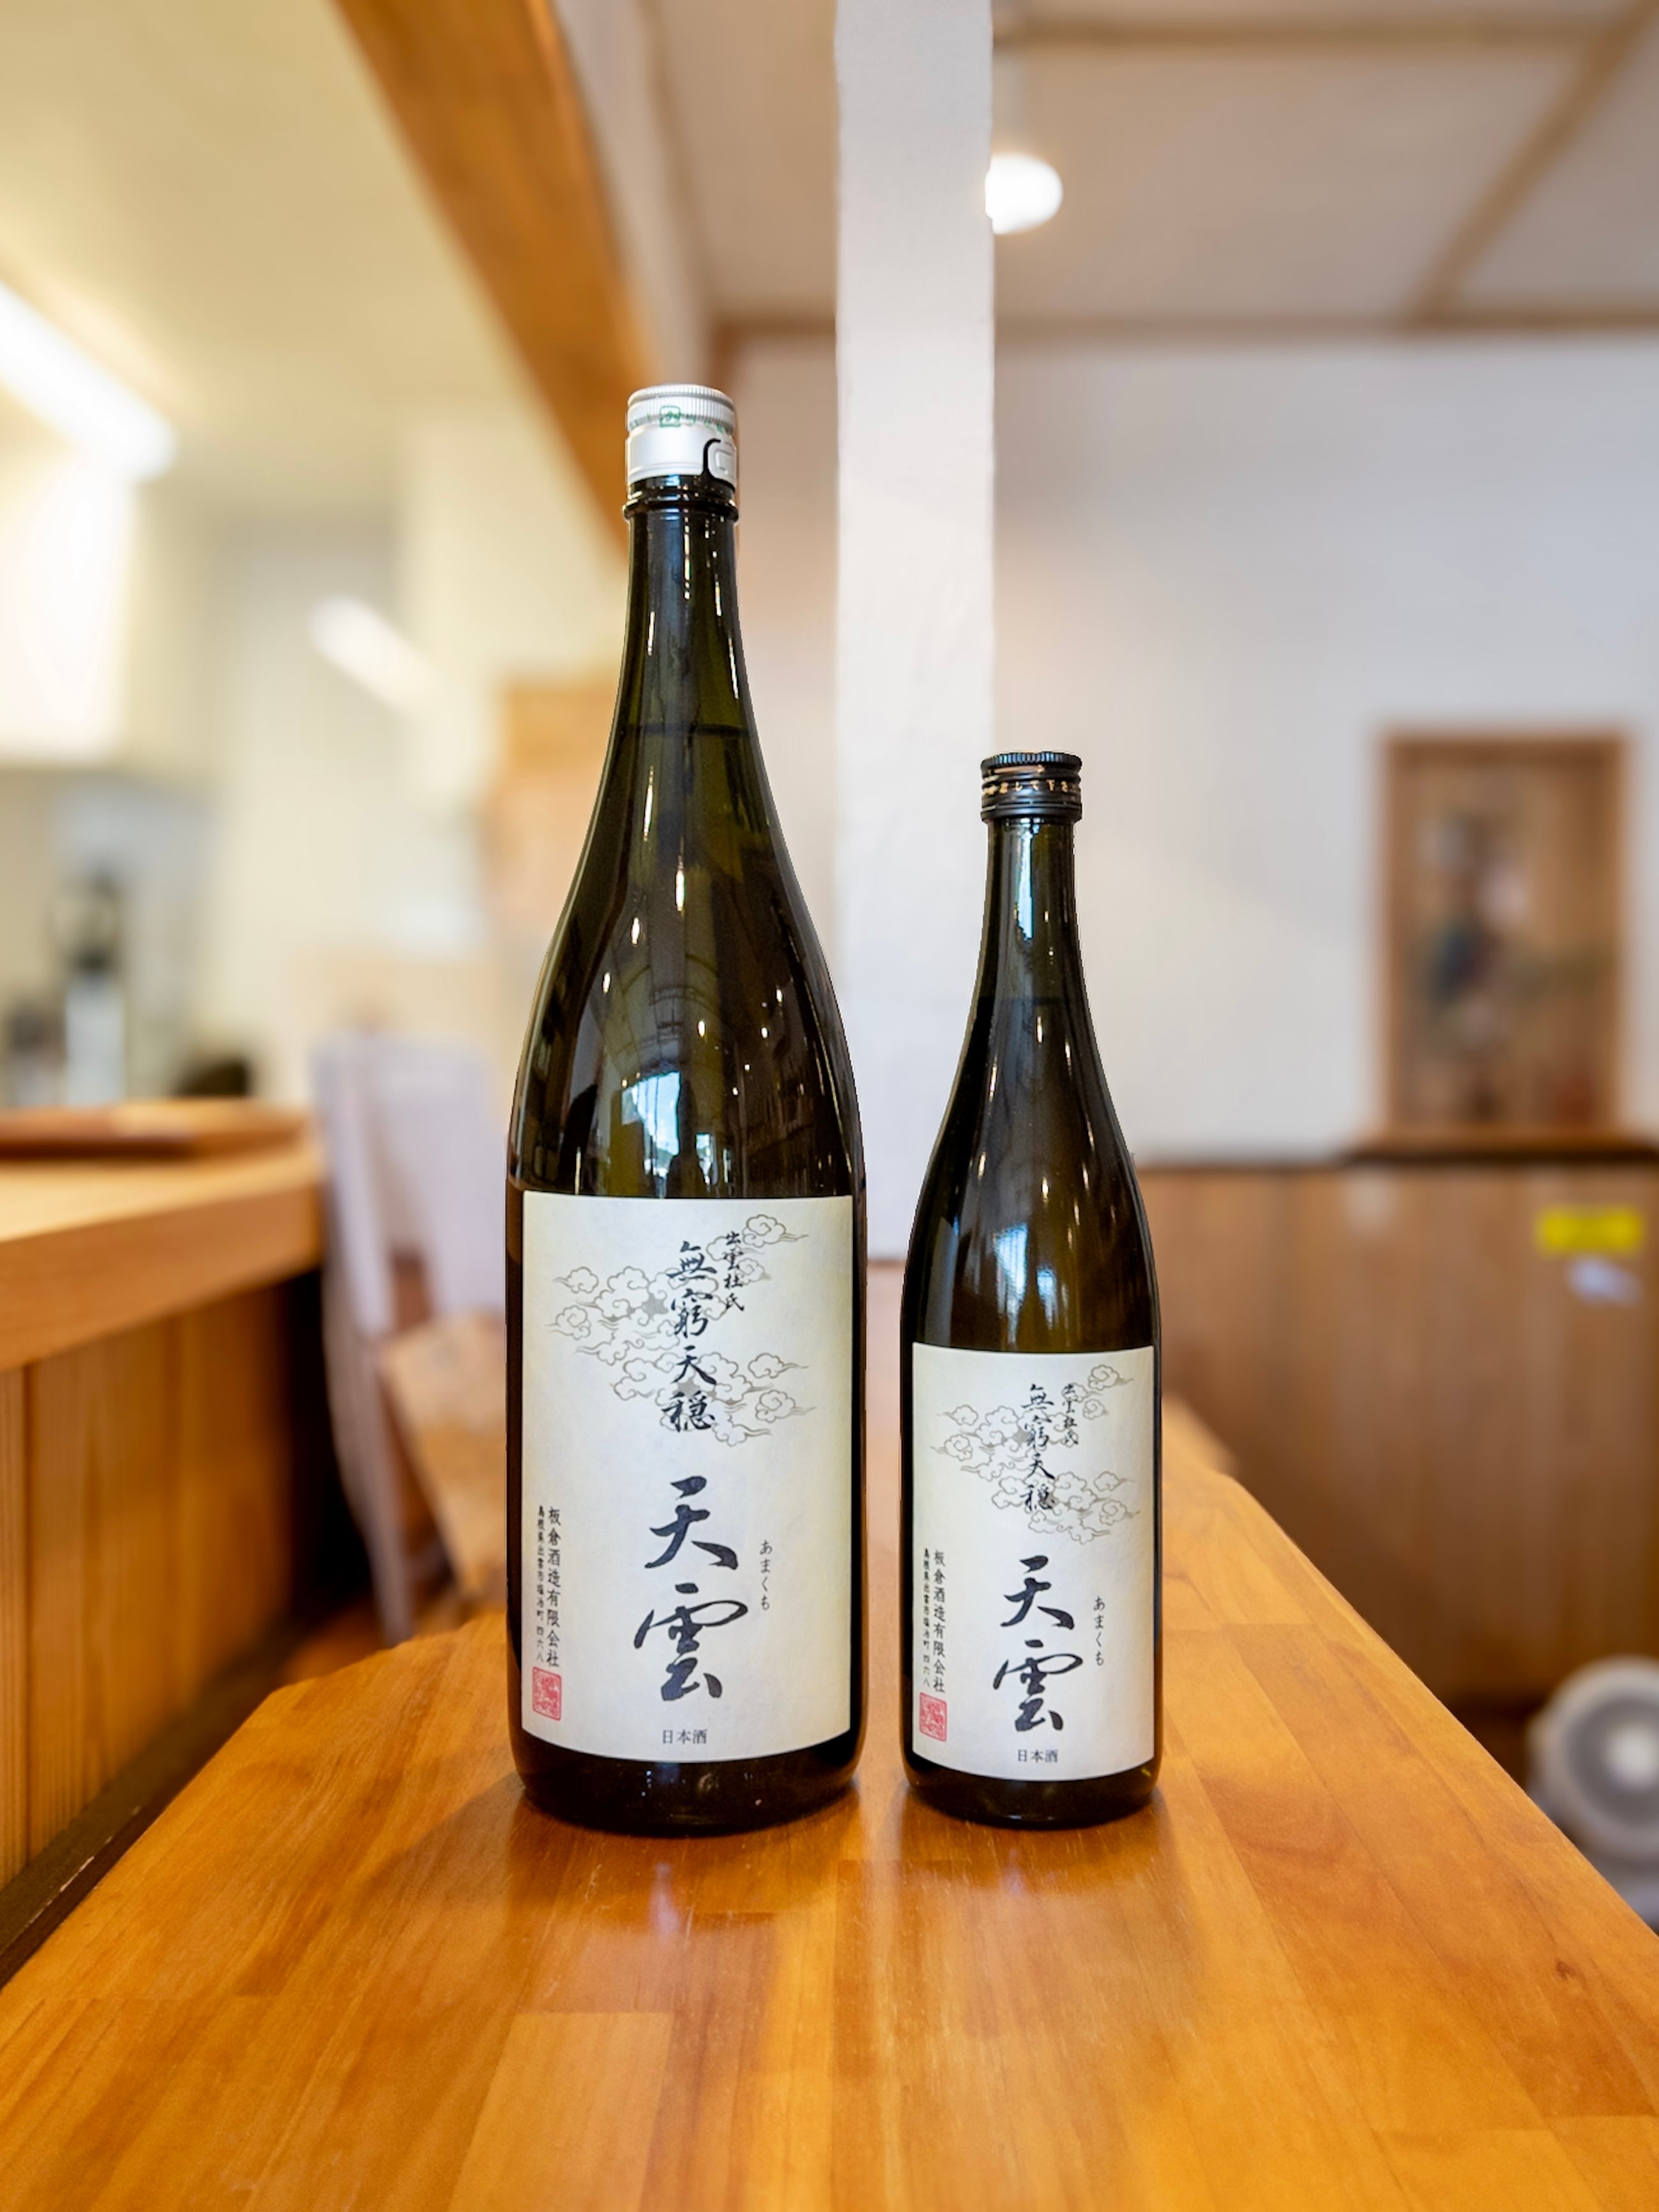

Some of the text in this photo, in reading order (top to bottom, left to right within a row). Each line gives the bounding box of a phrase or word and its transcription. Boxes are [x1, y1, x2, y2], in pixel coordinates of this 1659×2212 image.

[547, 1506, 561, 1666] 板倉酒造有限会社
[633, 1475, 748, 1701] 天雲
[759, 1540, 773, 1610] あまくも
[933, 1550, 945, 1692] 板倉酒造有限会社
[992, 1555, 1083, 1732] 天雲
[1093, 1596, 1105, 1666] あまくも
[662, 1729, 707, 1745] 日本酒
[1017, 1749, 1058, 1763] 日本酒
